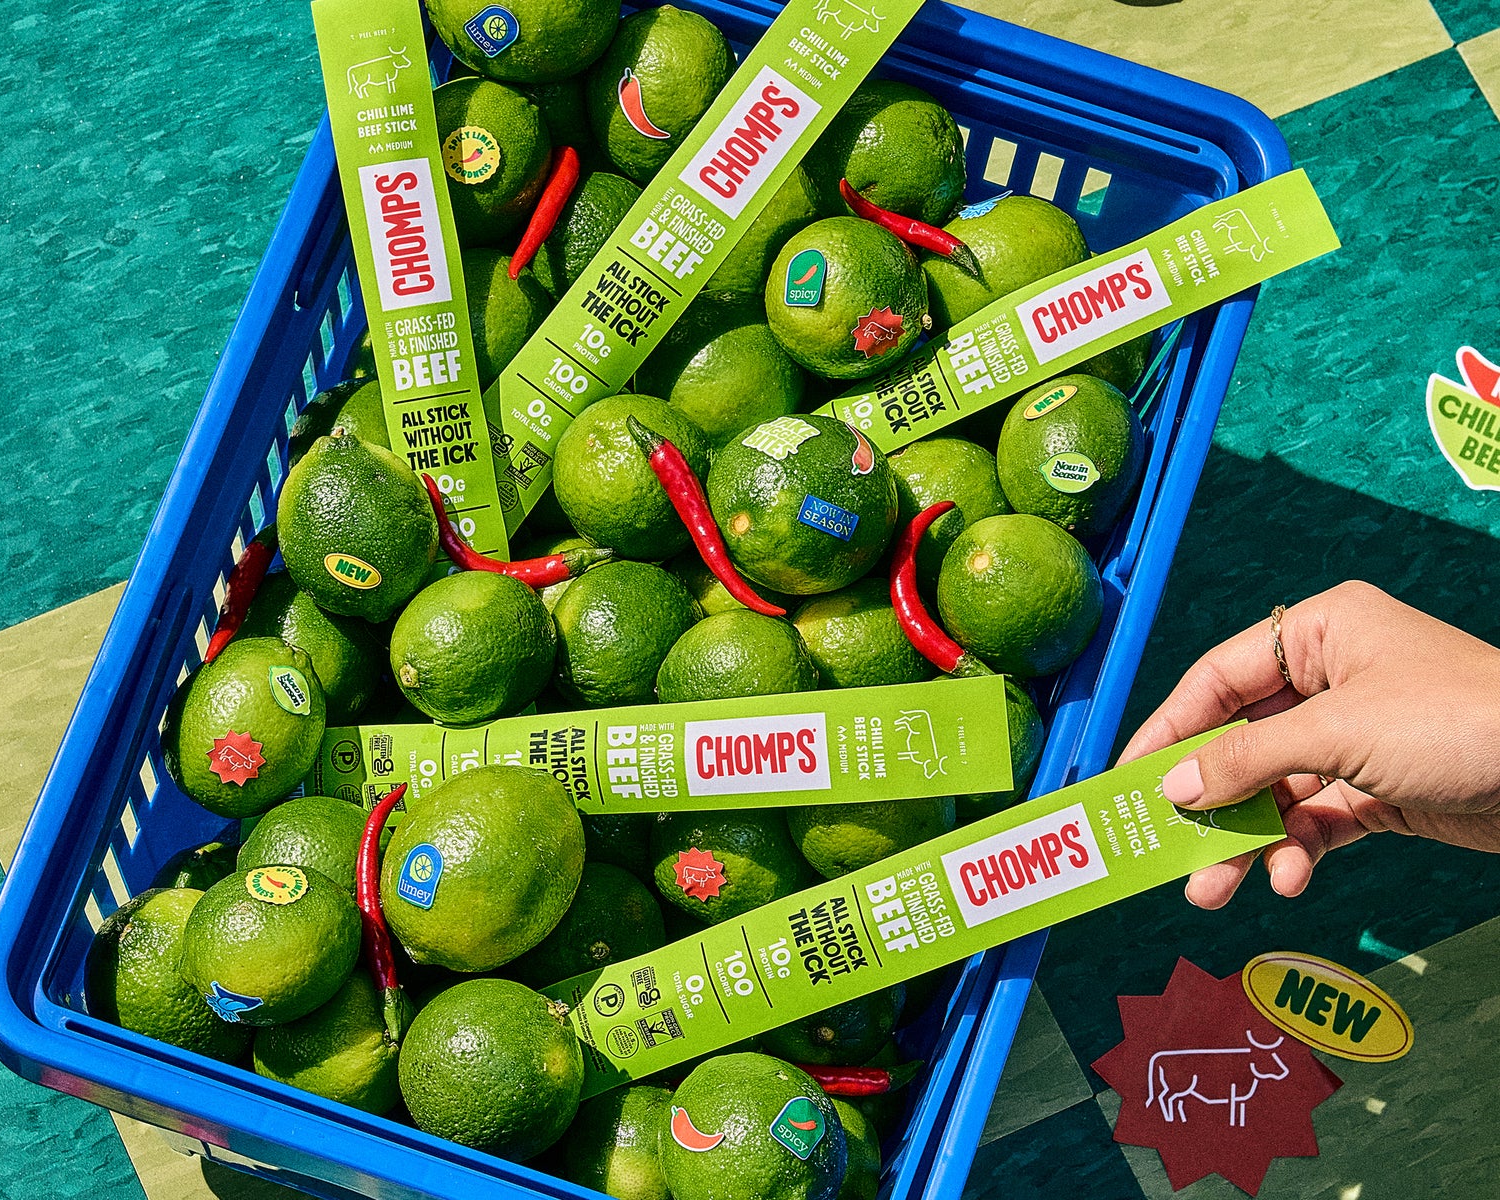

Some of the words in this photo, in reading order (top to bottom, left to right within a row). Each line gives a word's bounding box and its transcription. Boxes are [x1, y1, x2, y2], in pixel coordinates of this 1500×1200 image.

[467, 22, 497, 54] limey
[799, 26, 828, 54] CHILI
[825, 45, 850, 68] LIME
[787, 38, 812, 58] BEEF
[810, 52, 840, 81] STICK
[797, 67, 823, 90] MEDIUM
[357, 106, 388, 122] CHILI
[391, 103, 414, 116] LIME
[358, 124, 382, 138] BEEF
[385, 120, 417, 135] STICK
[448, 131, 470, 151] SPICY
[472, 131, 496, 151] LIMEY
[699, 83, 800, 199] CHOMPS
[386, 140, 413, 151] MEDIUM
[451, 162, 491, 178] GOODNESS
[650, 201, 664, 218] MADE
[662, 186, 676, 203] WITH
[658, 208, 672, 223] &
[668, 215, 714, 255] FINISHED
[670, 194, 726, 241] GRASS-FED
[375, 171, 435, 296] CHOMPS
[629, 217, 704, 280] BEEF
[1175, 234, 1192, 258] BEEF
[1184, 254, 1206, 287] STICK
[1189, 229, 1207, 255] CHILI
[1203, 255, 1220, 280] LIME
[606, 260, 631, 284] ALL
[628, 275, 671, 314] STICK
[1166, 259, 1183, 287] MEDIUM
[581, 290, 615, 324] THE
[596, 274, 659, 329] WITHOUT
[789, 288, 817, 301] spicy
[1032, 263, 1153, 344] CHOMPS
[385, 322, 393, 339] WITH
[395, 312, 455, 336] GRASS-FED
[975, 323, 991, 334] MADE
[991, 313, 1006, 326] WITH
[977, 330, 993, 341] &
[398, 340, 407, 356] &
[410, 332, 458, 353] FINISHED
[573, 343, 600, 365] PROTEIN
[579, 323, 611, 358] 10G
[994, 322, 1029, 376] GRASS-FED
[392, 350, 462, 392] BEEF
[913, 356, 927, 375] ALL
[947, 331, 995, 395] BEEF
[980, 337, 1011, 384] FINISHED
[544, 377, 574, 403] CALORIES
[548, 357, 589, 394] 100
[874, 374, 892, 401] THE
[893, 362, 930, 423] WITHOUT
[917, 371, 947, 416] STICK
[1033, 389, 1066, 413] NEW
[401, 410, 425, 429] ALL
[426, 403, 470, 424] STICK
[511, 408, 530, 427] TOTAL
[530, 420, 552, 443] SUGAR
[852, 395, 873, 430] 10G
[403, 421, 472, 449] WITHOUT
[758, 424, 804, 447] BIGGER
[770, 417, 819, 438] TAKE
[523, 447, 545, 465] PROJECT
[744, 431, 796, 459] BITES
[407, 449, 441, 471] THE
[1054, 460, 1078, 473] Now
[1078, 463, 1089, 474] in
[427, 474, 465, 494] 0G
[1051, 470, 1087, 482] Season
[443, 495, 464, 504] OTEIN
[810, 501, 840, 520] NOW
[841, 513, 854, 525] IN
[803, 509, 851, 536] SEASON
[335, 558, 372, 583] NEW
[570, 728, 586, 754] ALL
[639, 724, 657, 732] MADE
[658, 722, 675, 731] WITH
[639, 735, 656, 745] &
[854, 716, 867, 743] BEEF
[870, 717, 884, 750] CHILI
[380, 737, 388, 759] GLUTEN
[408, 750, 417, 772] TOTAL
[529, 729, 548, 765] THE
[550, 728, 572, 793] WITHO
[696, 728, 817, 780] CHOMPS
[838, 743, 849, 774] MEDIUM
[607, 726, 643, 799] BEEF
[639, 747, 660, 798] FINISHED
[658, 733, 678, 798] GRASS-FED
[856, 745, 870, 780] STICK
[873, 753, 887, 779] LIME
[410, 774, 420, 799] SUGAR
[571, 755, 592, 801] STICK
[1113, 794, 1131, 820] BEEF
[1124, 820, 1146, 858] STICK
[1130, 789, 1151, 823] CHILI
[1142, 823, 1161, 851] LIME
[1105, 826, 1122, 857] MEDIUM
[276, 868, 301, 878] SPICY
[897, 866, 914, 880] MADE
[914, 860, 932, 875] WITH
[959, 823, 1089, 907] CHOMPS
[252, 872, 275, 898] GOODNESS
[288, 879, 303, 898] LIMEY
[400, 879, 432, 903] limey
[900, 878, 916, 892] &
[830, 897, 850, 925] ALL
[865, 875, 920, 953] BEEF
[903, 888, 937, 945] FINISHED
[918, 872, 956, 938] GRASS-FED
[788, 908, 815, 948] THE
[810, 901, 852, 976] WITHOUT
[768, 937, 791, 979] 10G
[838, 923, 869, 971] STICK
[635, 971, 643, 985] FREE
[724, 950, 754, 996] 100
[758, 948, 775, 980] PROTEIN
[642, 969, 652, 991] GLUTEN
[715, 961, 734, 998] CALORIES
[672, 970, 685, 994] TOTAL
[679, 994, 694, 1020] SUGAR
[1274, 968, 1382, 1043] NEW
[641, 1019, 655, 1046] VERIFIED
[662, 1011, 678, 1038] PROJECT
[777, 1124, 810, 1153] spicy
